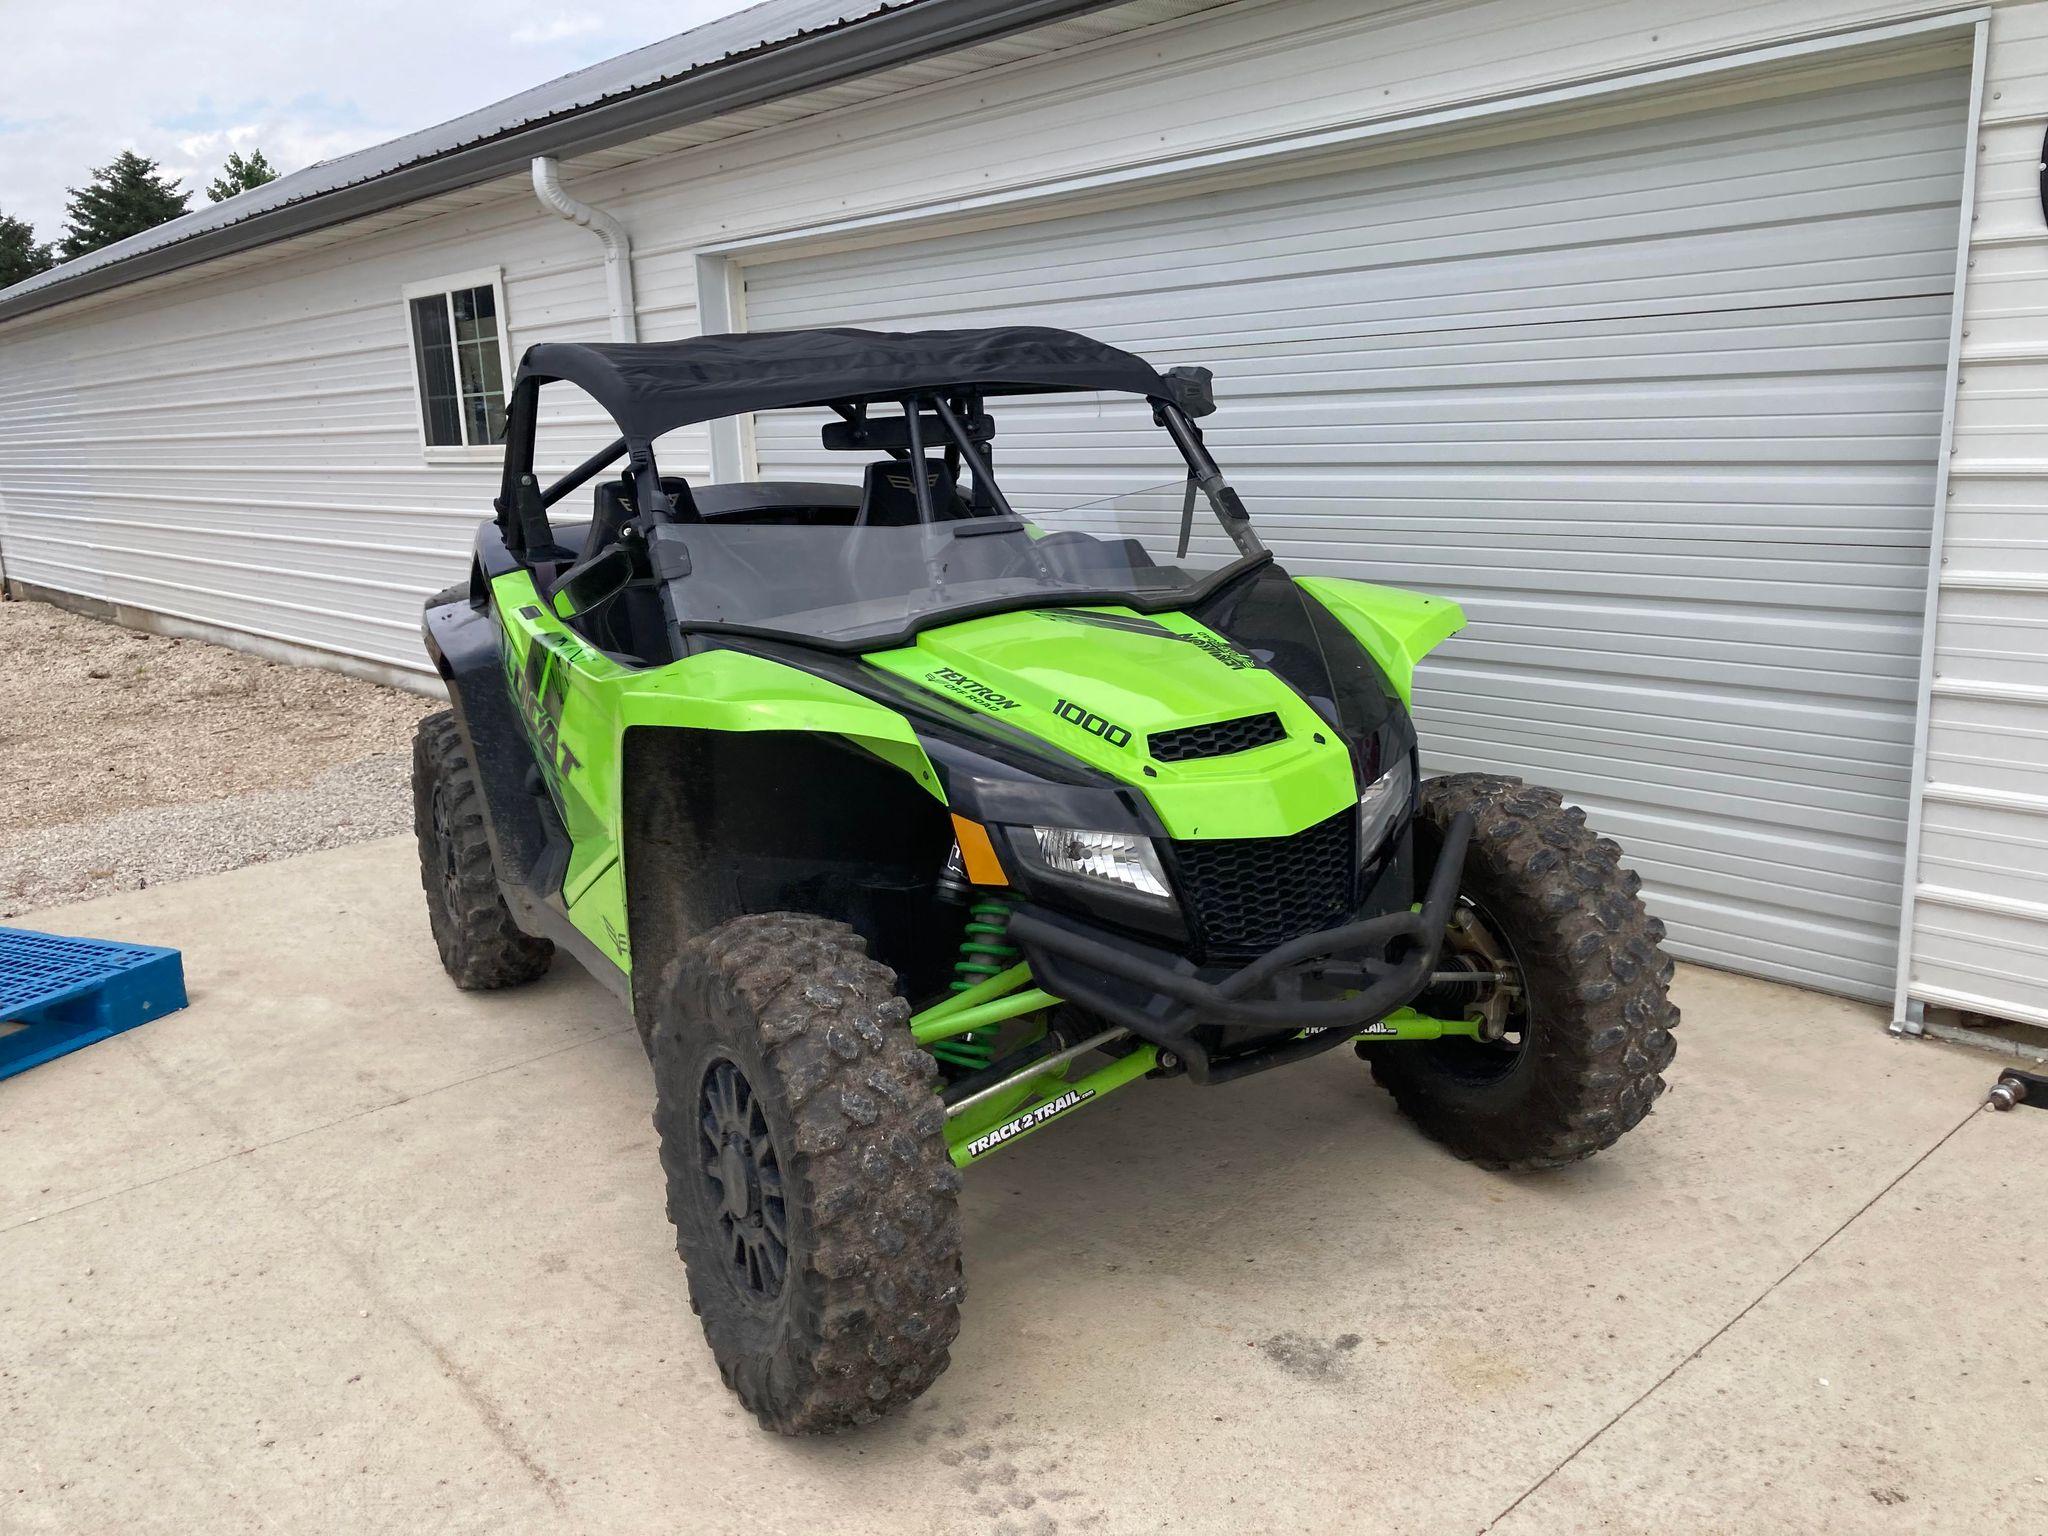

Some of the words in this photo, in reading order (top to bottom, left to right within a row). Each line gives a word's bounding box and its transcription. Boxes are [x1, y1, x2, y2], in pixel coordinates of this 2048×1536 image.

[933, 666, 1021, 709] TEXTRON
[944, 684, 967, 695] OFF
[965, 694, 1000, 711] ROAD
[1052, 698, 1132, 748] 1000
